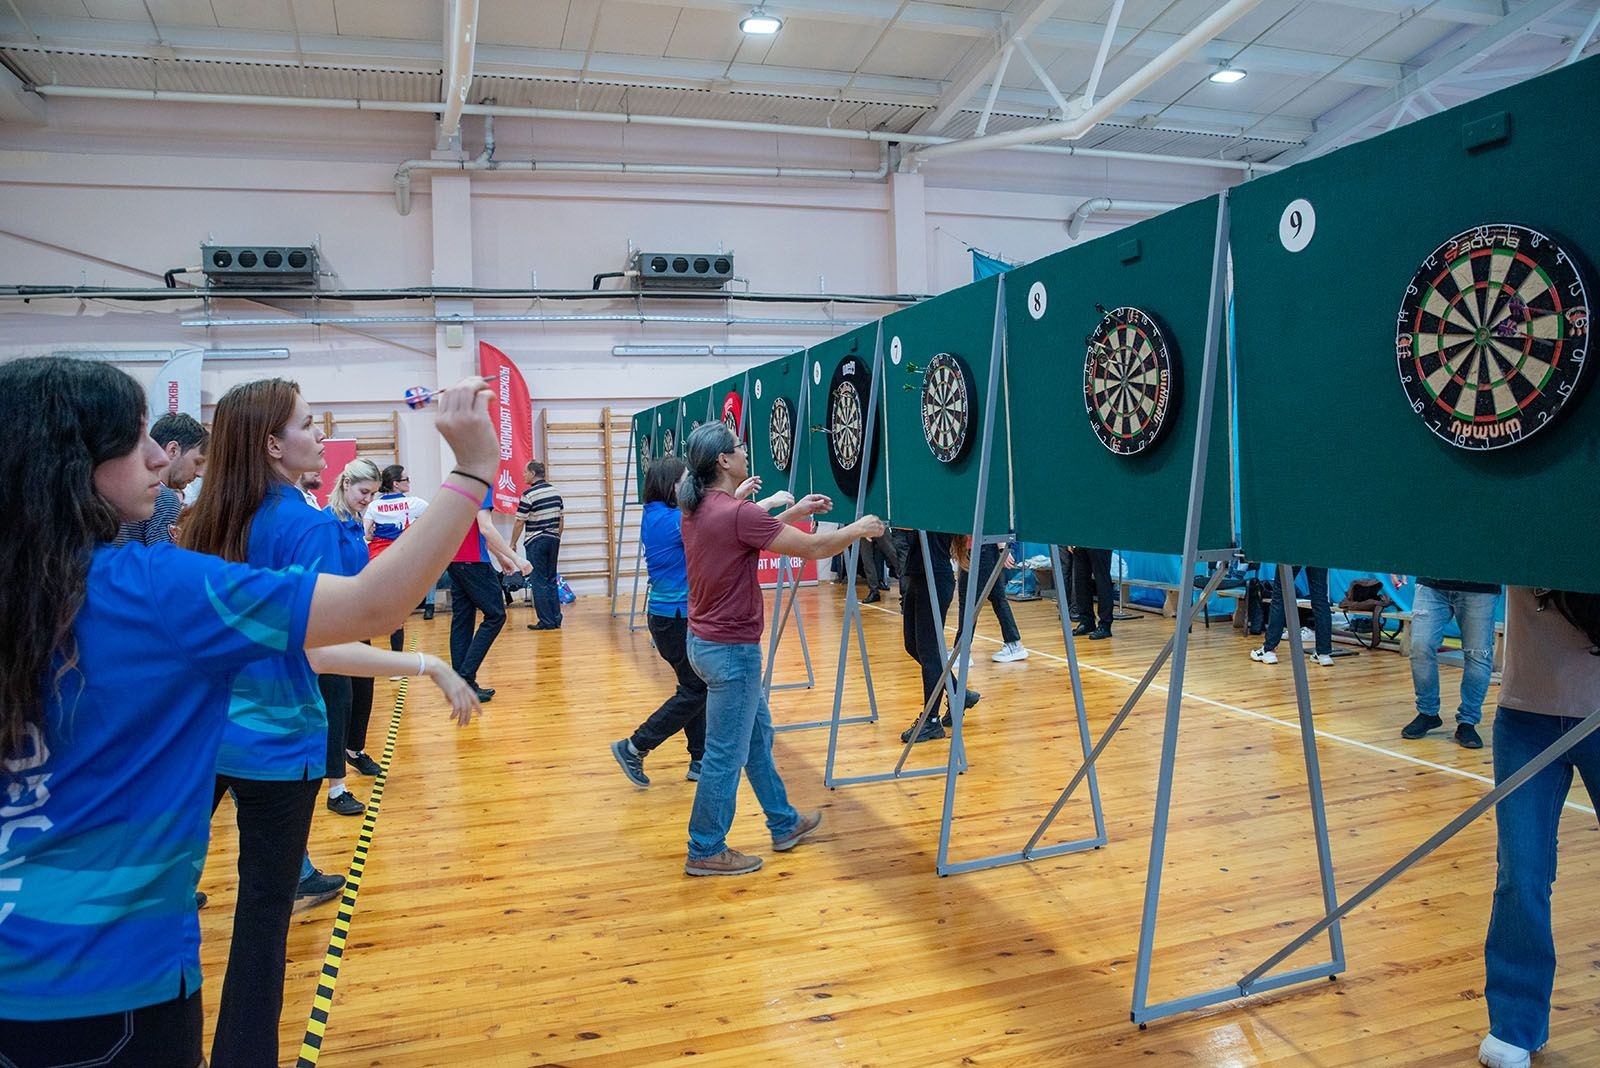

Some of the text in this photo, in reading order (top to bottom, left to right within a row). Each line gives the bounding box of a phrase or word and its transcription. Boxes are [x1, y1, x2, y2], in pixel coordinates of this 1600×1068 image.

[1289, 209, 1303, 239] 9
[1474, 225, 1489, 239] 20
[1531, 231, 1544, 248] 18
[1458, 235, 1520, 255] BLADE
[1421, 255, 1438, 270] 12
[1555, 253, 1567, 265] 4
[1406, 285, 1418, 295] 9
[1568, 277, 1583, 297] 13
[1033, 292, 1041, 312] 8
[1398, 309, 1409, 323] 14
[1571, 348, 1585, 364] 10
[1402, 374, 1412, 384] 8
[1557, 380, 1573, 400] 15
[499, 365, 513, 460] ЧЕМПИОНАТ МОСКВЫ
[1413, 398, 1425, 413] 16
[1537, 411, 1550, 423] 2
[1431, 419, 1441, 432] 7
[1453, 432, 1466, 448] 19
[377, 502, 410, 513] МОСКВА
